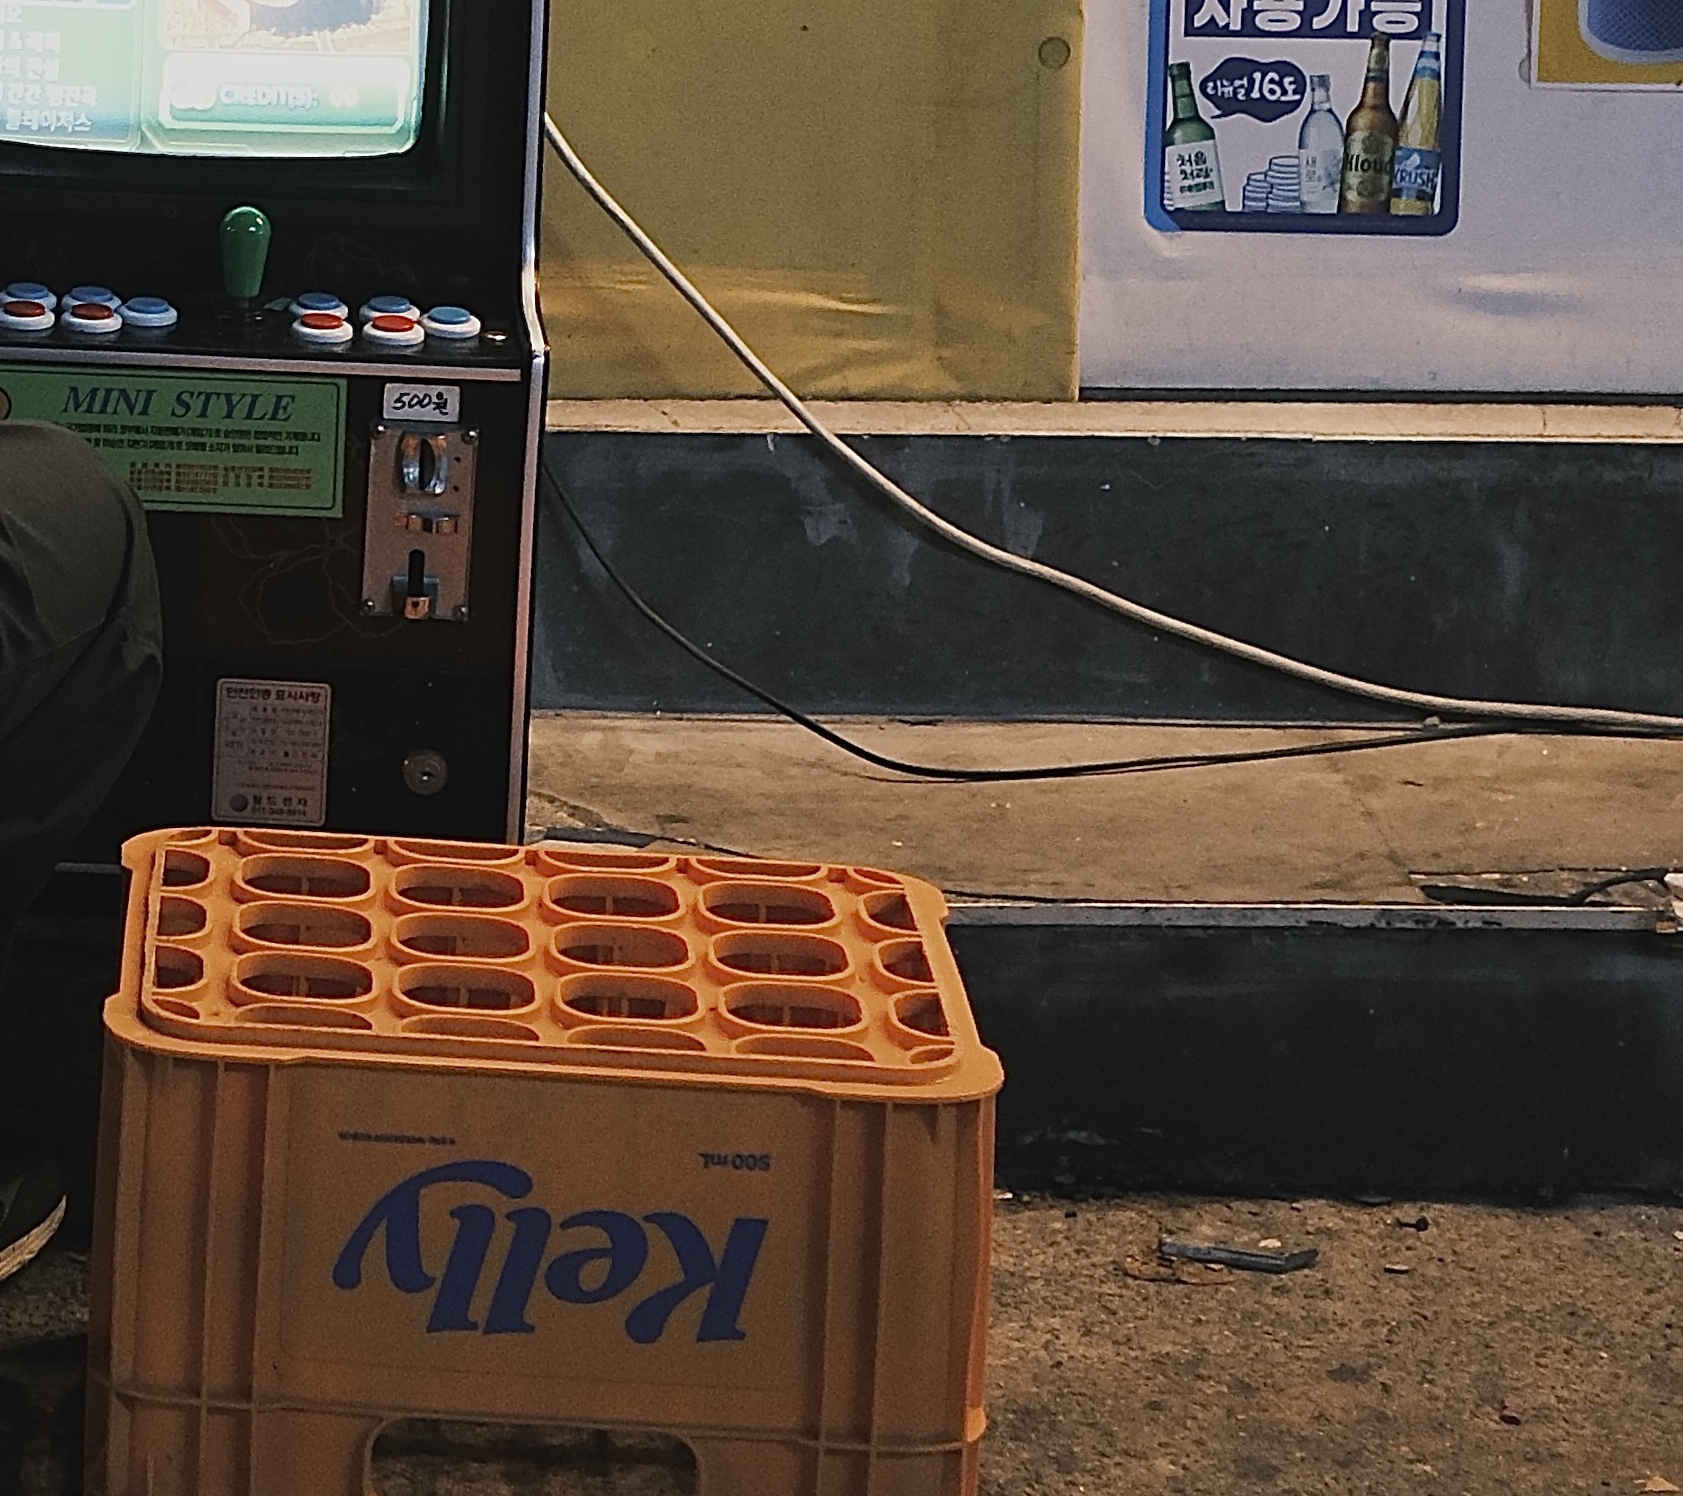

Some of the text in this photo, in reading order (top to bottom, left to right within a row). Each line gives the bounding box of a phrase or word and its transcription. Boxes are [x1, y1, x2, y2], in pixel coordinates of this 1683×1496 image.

[1250, 71, 1301, 102] 16도
[61, 385, 296, 422] MINI STYLE
[392, 391, 449, 416] 500원
[732, 1152, 771, 1171] 500
[331, 1158, 770, 1345] Kelly
